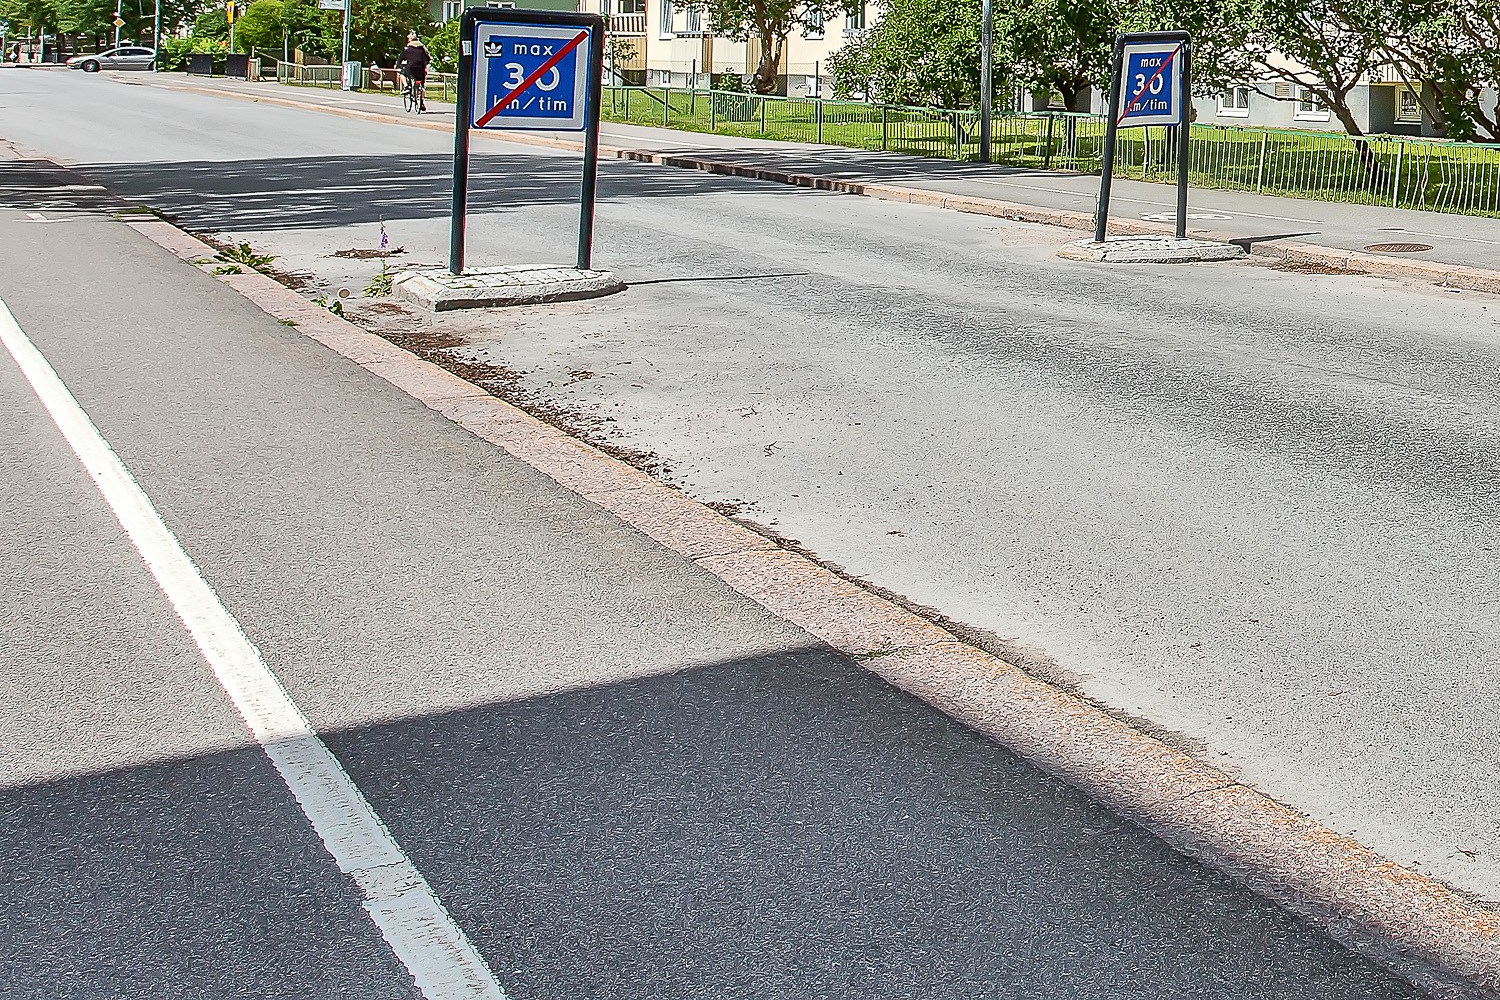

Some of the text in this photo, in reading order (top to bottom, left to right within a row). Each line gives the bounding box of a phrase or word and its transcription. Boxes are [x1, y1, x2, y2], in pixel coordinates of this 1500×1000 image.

[513, 43, 553, 56] max
[1140, 57, 1162, 68] max
[502, 62, 560, 92] 30
[1132, 73, 1164, 96] 30
